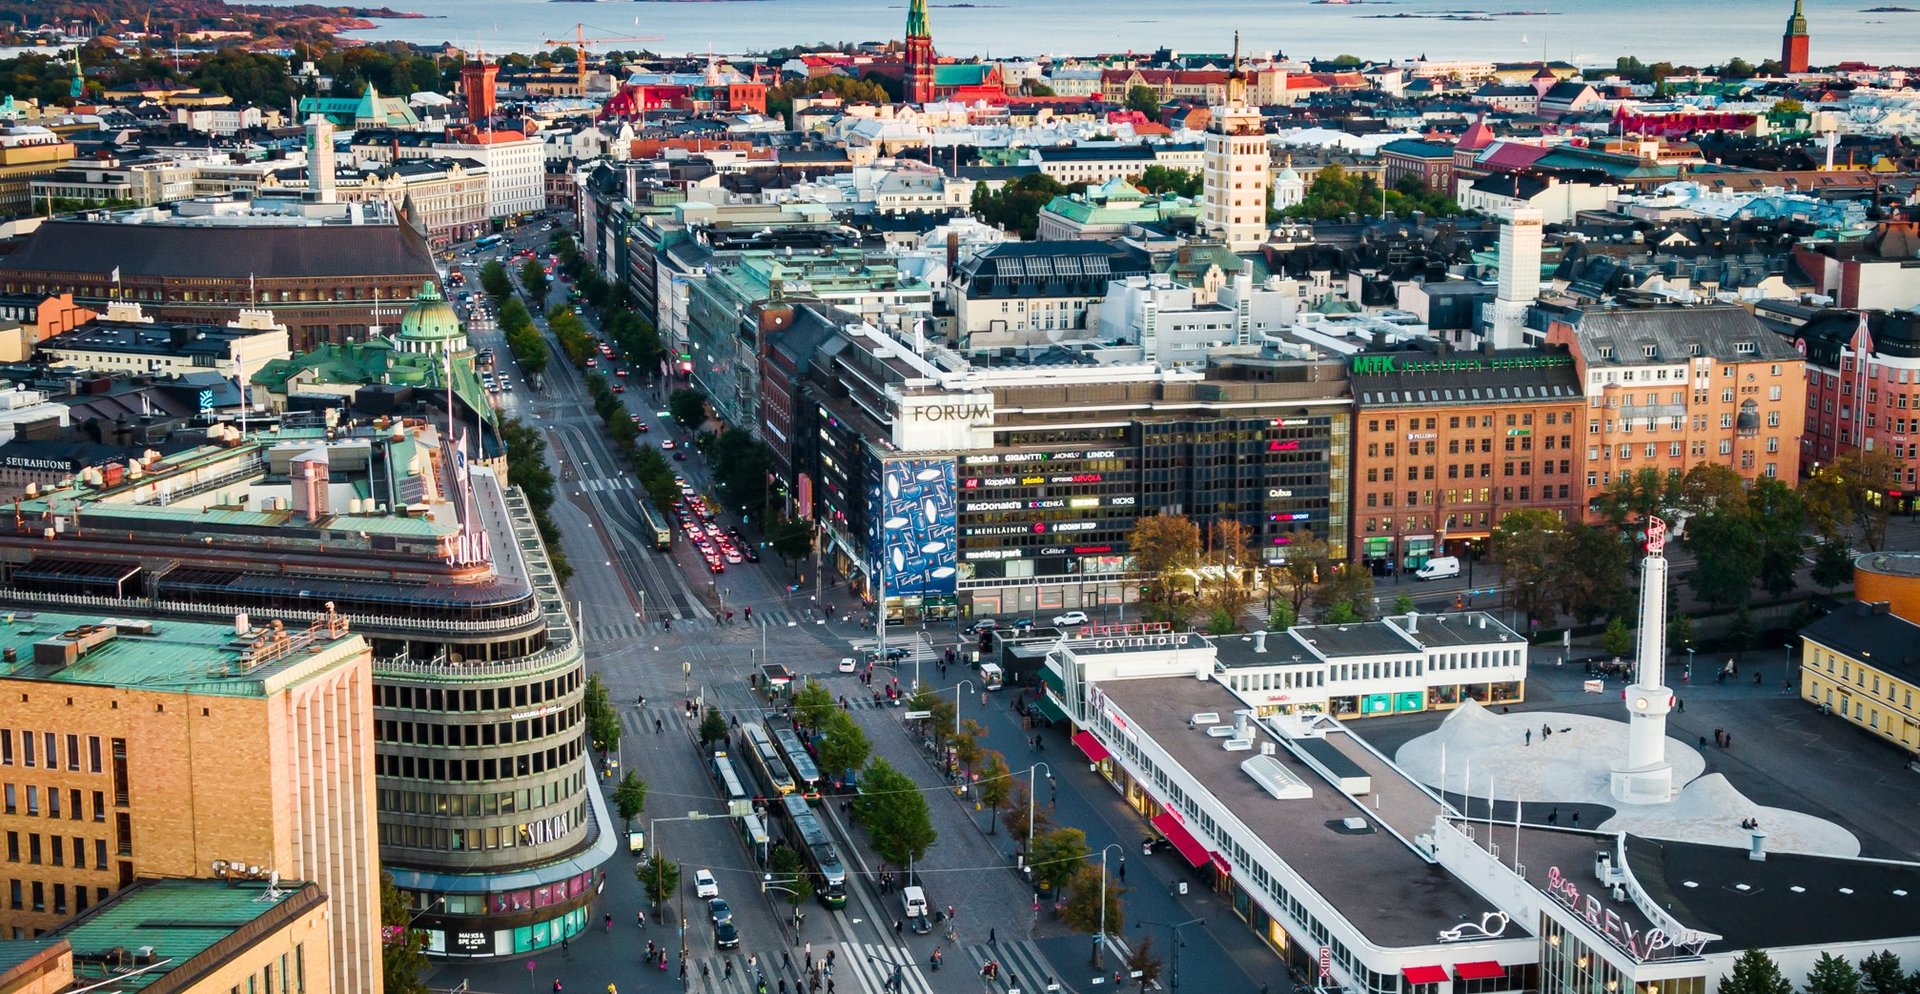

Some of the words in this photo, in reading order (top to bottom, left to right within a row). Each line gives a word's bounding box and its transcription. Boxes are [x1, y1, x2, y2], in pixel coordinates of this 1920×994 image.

[1354, 357, 1394, 373] MTK
[915, 404, 989, 421] FORUM
[1005, 453, 1041, 462] GIGANTTI
[1087, 451, 1115, 459] LINDEX
[6, 457, 71, 470] SEURAHUONE
[985, 478, 1015, 486] KappAhl
[1269, 489, 1292, 497] Cubus
[967, 500, 1021, 511] McDonald's
[1112, 497, 1135, 505] KICKS
[975, 526, 1028, 535] MEHILÄINEN
[966, 551, 1000, 560] meeting
[1002, 549, 1021, 558] park
[1041, 547, 1066, 555] Glitter
[1095, 631, 1188, 648] ravintola
[528, 814, 568, 846] SOKOS
[1586, 894, 1645, 964] REX
[1320, 948, 1330, 977] REX
